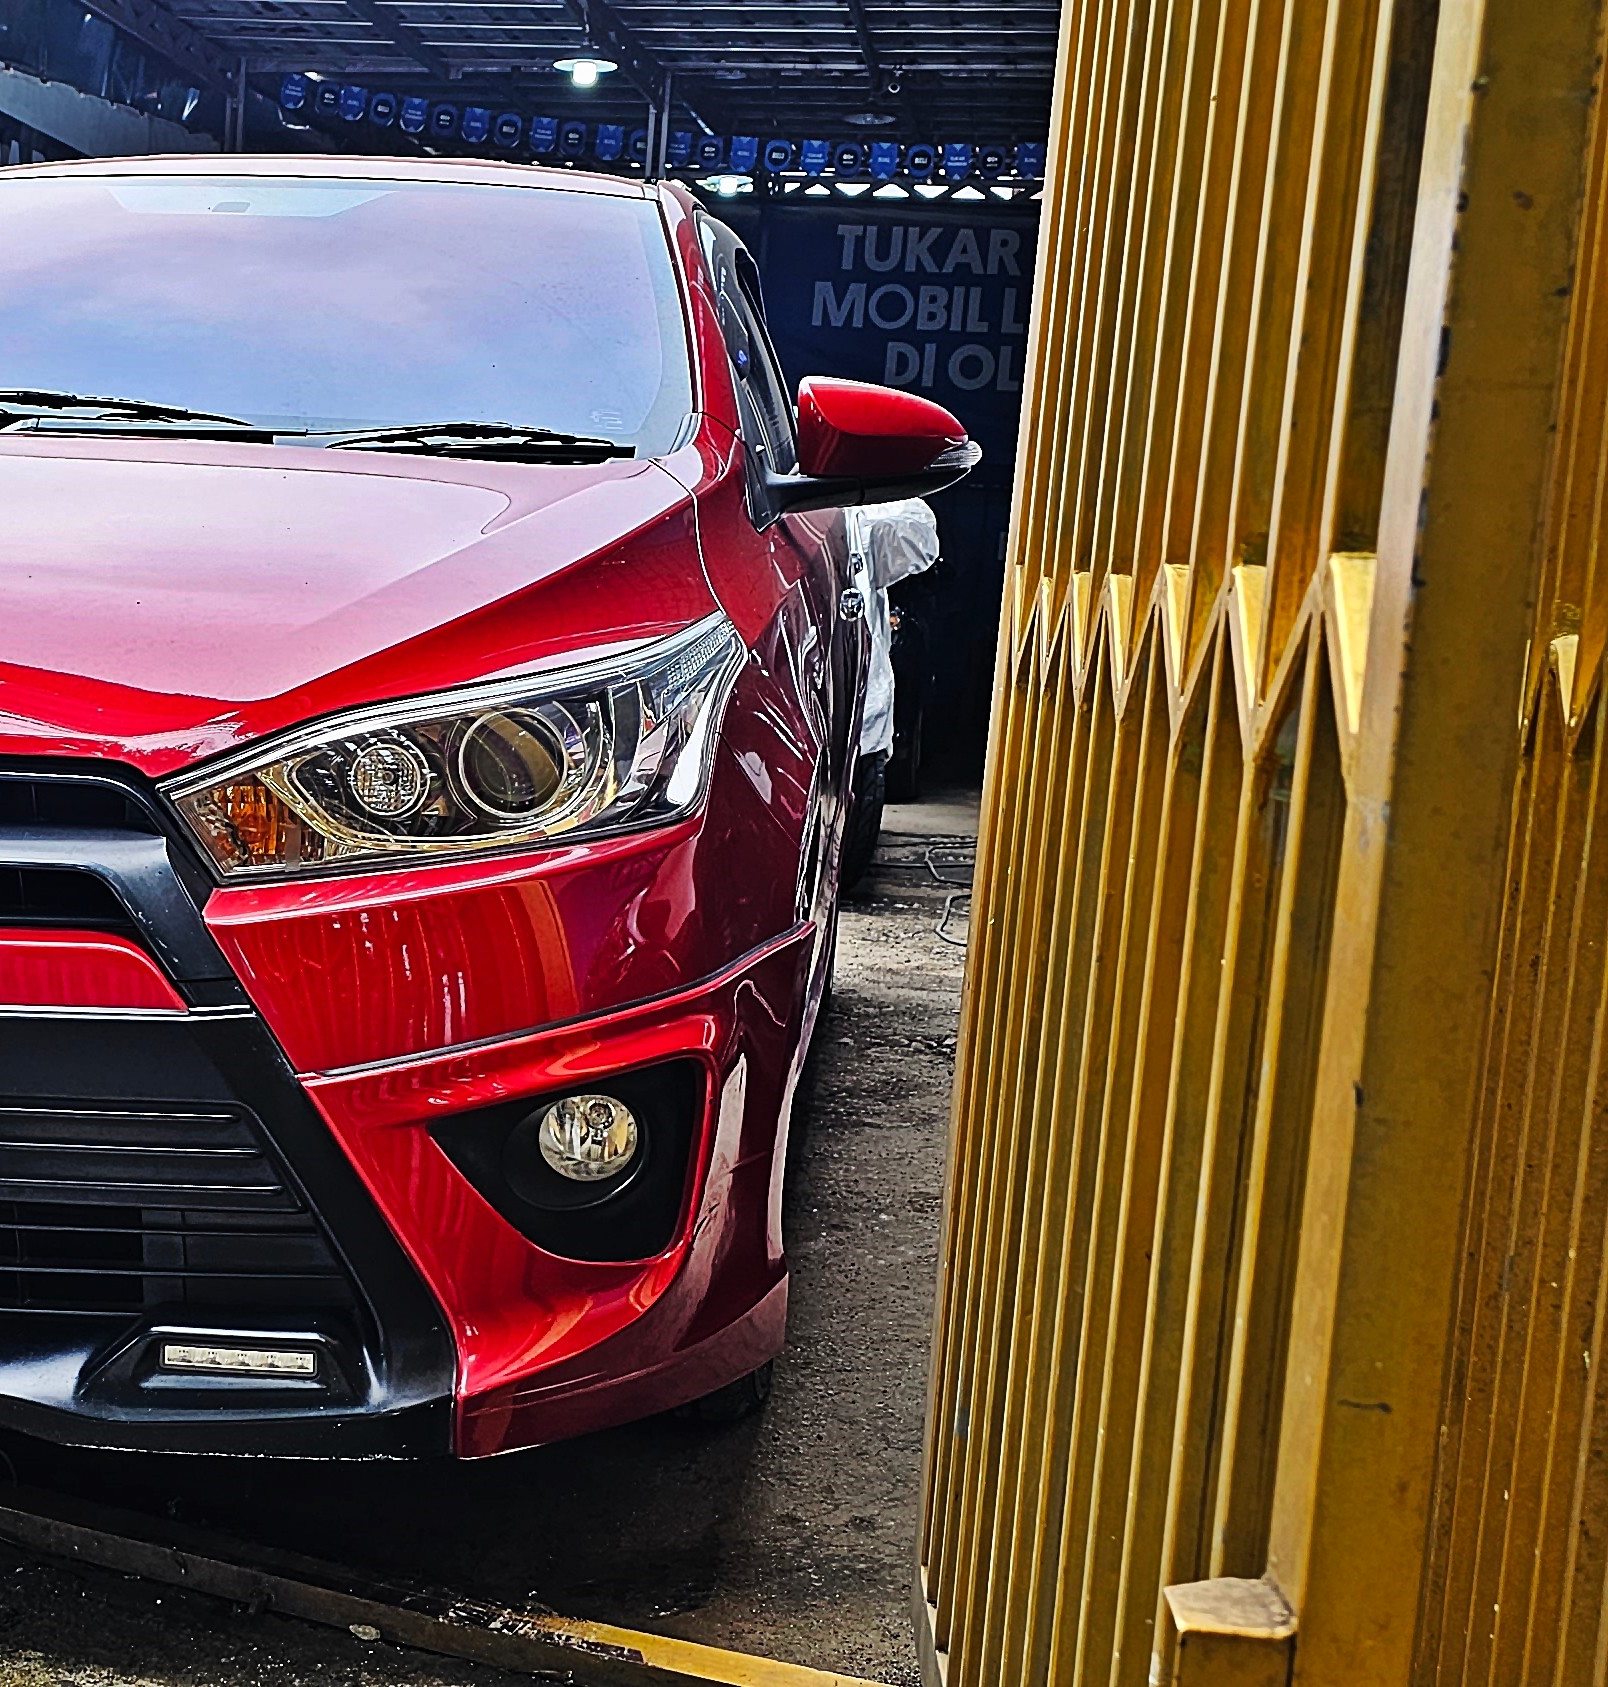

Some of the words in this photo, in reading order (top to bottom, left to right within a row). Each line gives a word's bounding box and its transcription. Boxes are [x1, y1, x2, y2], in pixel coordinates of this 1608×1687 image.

[837, 224, 1022, 276] TUKAR
[811, 281, 989, 333] MOBIL
[884, 341, 936, 387] DI
